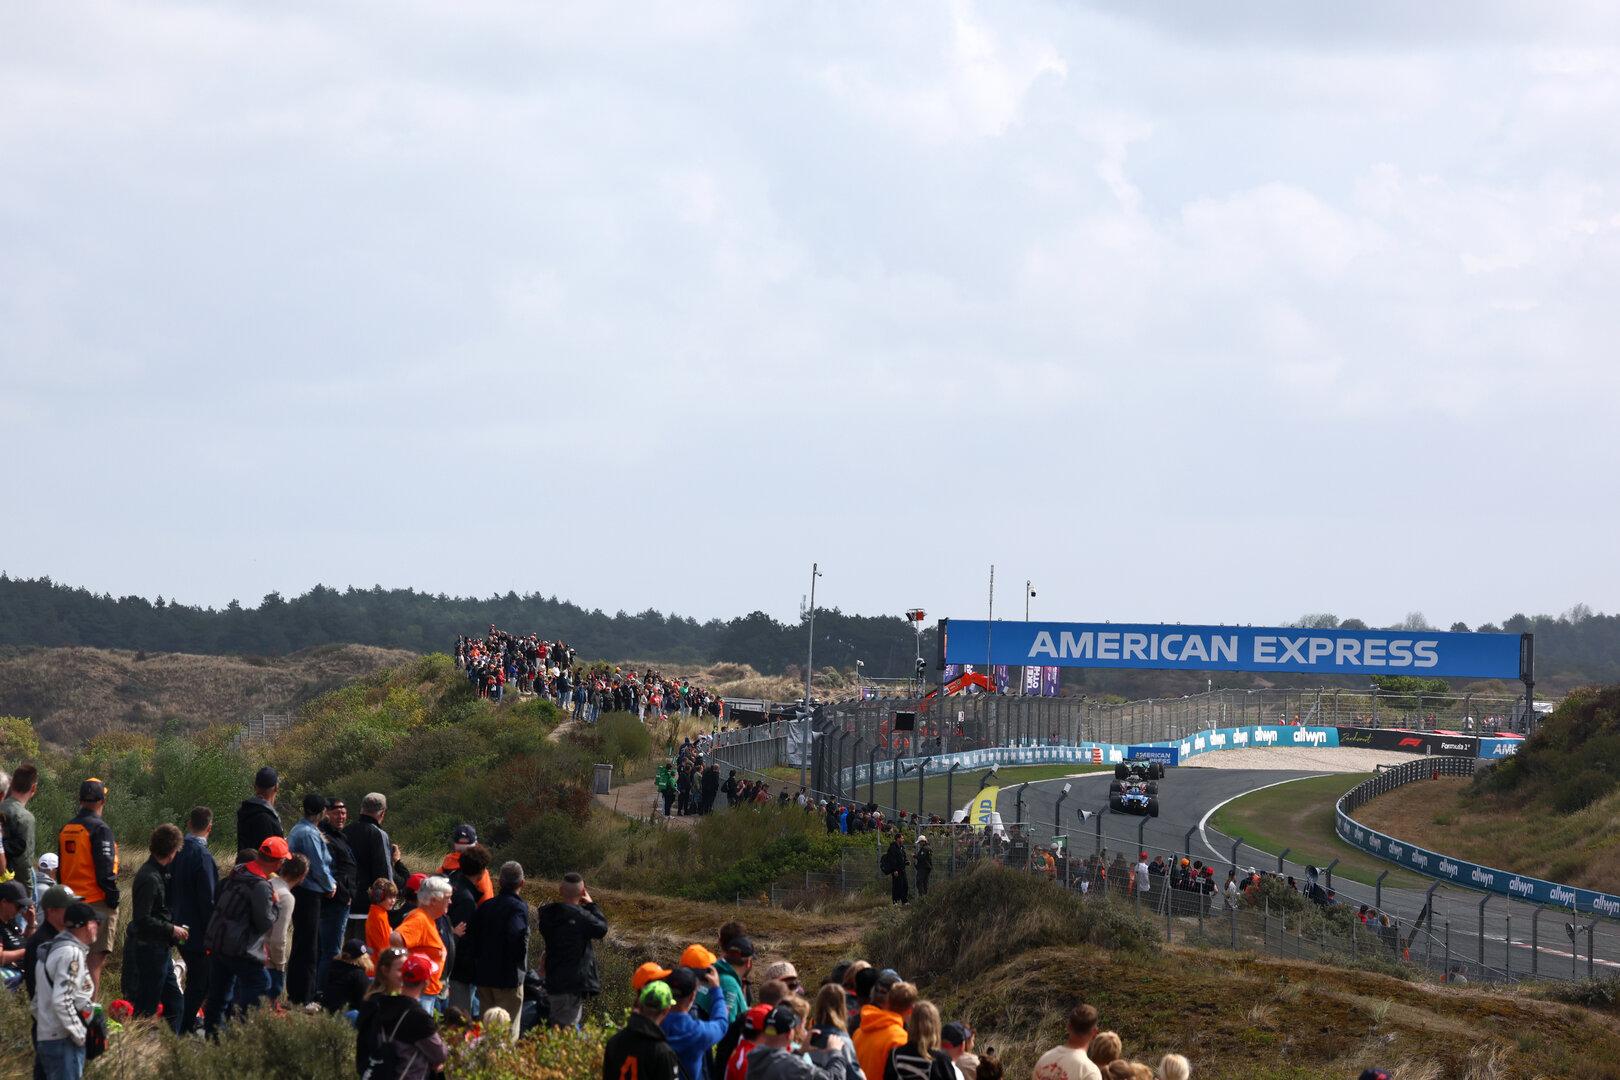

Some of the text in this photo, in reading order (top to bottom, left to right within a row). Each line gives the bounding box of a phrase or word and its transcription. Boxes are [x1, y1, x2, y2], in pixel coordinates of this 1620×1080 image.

[1027, 631, 1439, 668] AMERICAN EXPRESS
[1293, 726, 1327, 747] allwyn
[1441, 742, 1464, 750] Formula
[979, 800, 992, 824] AID
[1439, 858, 1458, 878] allwyn
[1471, 867, 1493, 887] allwyn
[1509, 876, 1534, 897] allwyn
[1550, 885, 1575, 906] allwyn
[1593, 894, 1620, 915] allwyn
